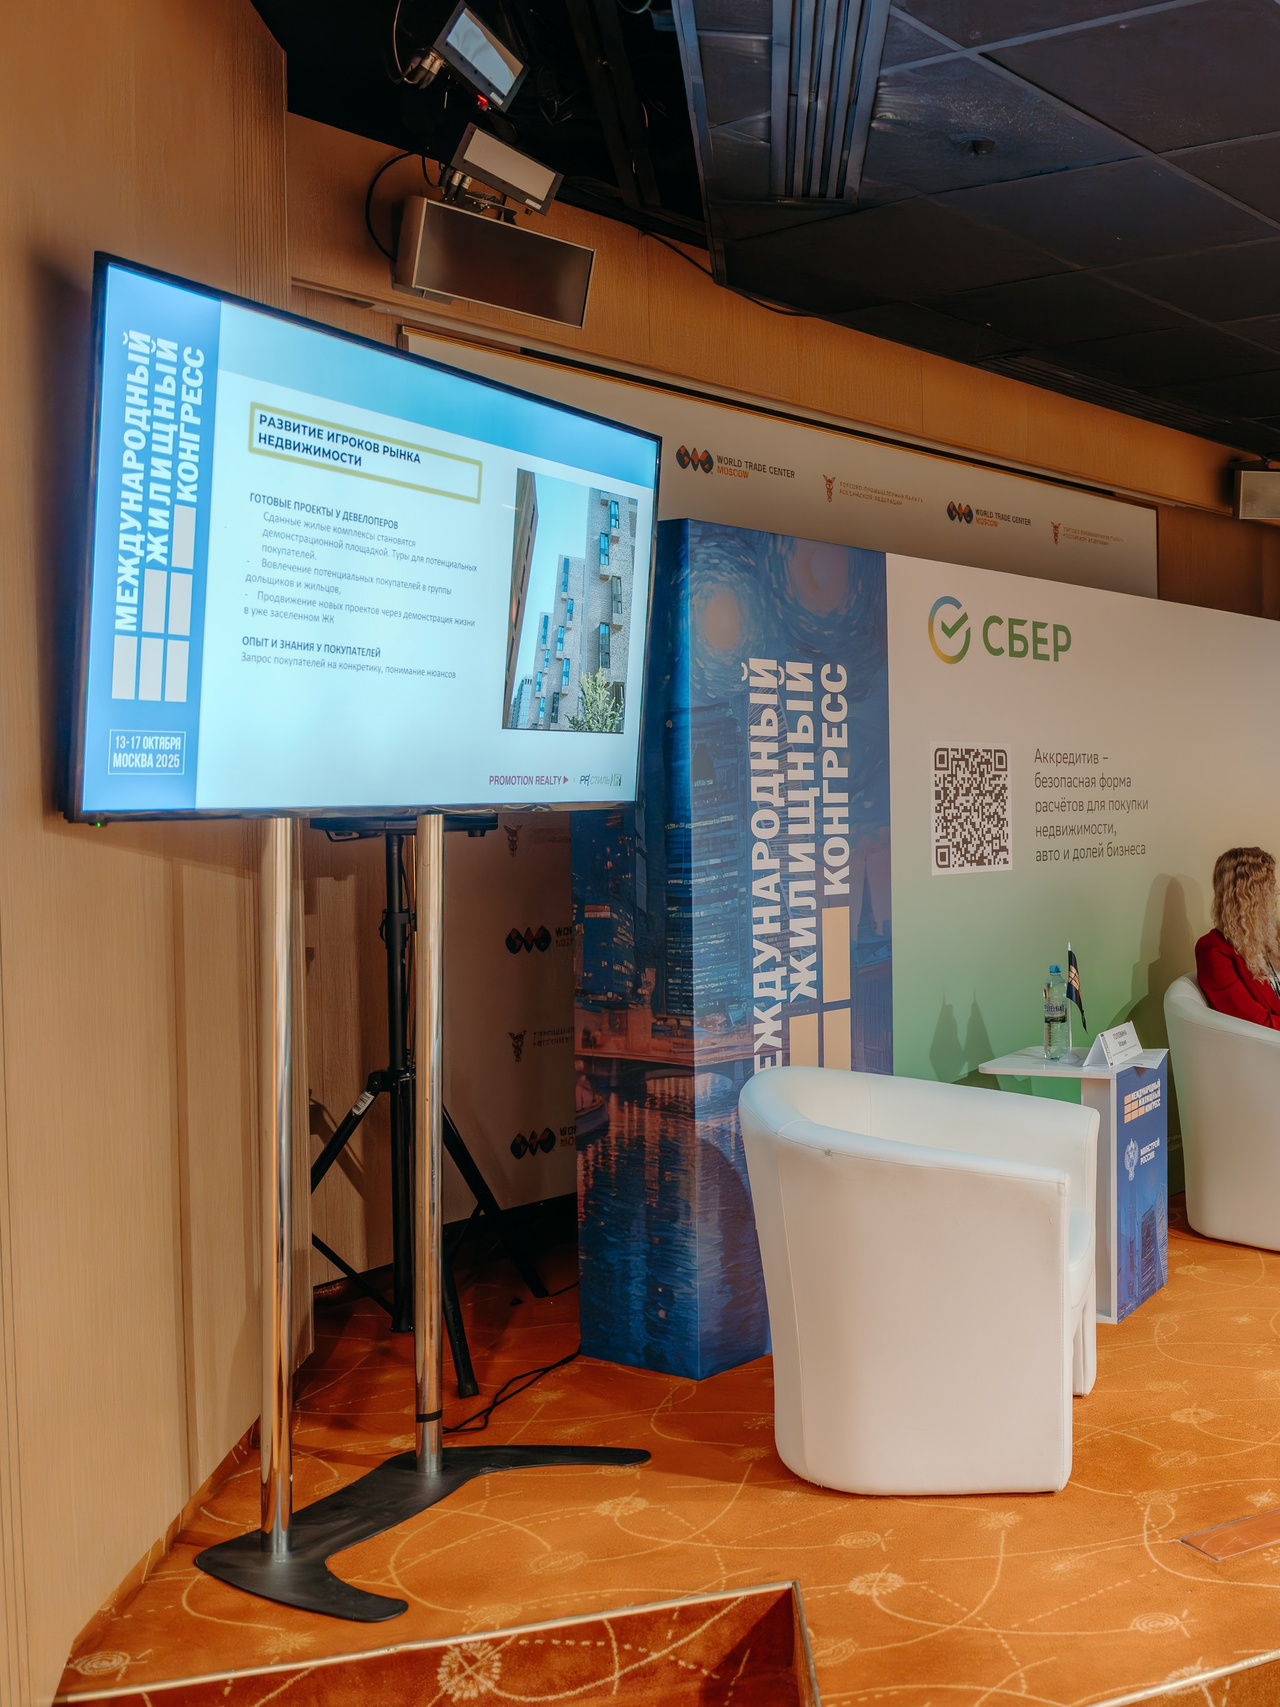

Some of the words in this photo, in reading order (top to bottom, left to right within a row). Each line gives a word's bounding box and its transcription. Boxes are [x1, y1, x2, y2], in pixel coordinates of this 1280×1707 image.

[176, 346, 205, 503] КОНГРЕСС
[146, 337, 179, 566] ЖИЛИЩНЫЙ
[258, 432, 362, 466] НЕДВИЖИМОСТИ
[259, 414, 324, 440] РАЗВИТИЕ
[326, 430, 380, 453] ИГРОКОВ
[382, 444, 421, 464] РЫНКА
[716, 454, 743, 468] WORLD
[745, 460, 767, 473] TRADE
[769, 465, 795, 479] CENTER
[717, 466, 749, 479] MOSCOW
[114, 329, 151, 631] МЕЖДУНАРОДНЫЙ
[249, 492, 292, 509] ГОТОВЫЕ
[294, 501, 333, 518] ПРОЕКТЫ
[335, 509, 341, 518] У
[342, 511, 399, 529] ДЕВЕЛОПЕРОВ
[975, 508, 994, 519] WORLD
[995, 511, 1011, 522] TRADE
[1012, 516, 1031, 526] CENTER
[975, 517, 998, 527] MOSCOW
[263, 511, 301, 527] Сданные
[303, 520, 331, 532] жилые
[332, 525, 375, 540] комплексы
[377, 535, 416, 547] становятся
[262, 528, 343, 549] демонстрационной
[345, 543, 390, 557] площадкой.
[392, 549, 410, 561] Туры
[411, 555, 424, 563] для
[425, 557, 478, 572] потенциальных
[262, 544, 317, 560] покупателей.
[245, 574, 294, 588] дольщиков
[303, 582, 341, 595] жильцов,
[261, 558, 312, 575] Вовлечение
[313, 567, 374, 584] потенциальных
[375, 577, 421, 591] покупателей
[427, 585, 452, 595] группы
[251, 607, 268, 617] уже
[270, 609, 320, 622] заселенном
[321, 614, 335, 624] ЖК
[257, 590, 317, 607] Продвижение
[318, 601, 343, 610] новых
[345, 603, 379, 615] проектов
[381, 608, 402, 619] через
[403, 611, 453, 625] демонстрация
[454, 619, 475, 627] жизни
[242, 636, 269, 647] ОПЫТ
[271, 639, 278, 649] И
[279, 639, 315, 652] ЗНАНИЯ
[316, 643, 322, 653] У
[324, 643, 381, 658] ПОКУПАТЕЛЕЙ
[982, 614, 1072, 663] СБЕР
[241, 652, 272, 665] Запрос
[273, 656, 326, 668] покупателей
[327, 661, 337, 669] на
[338, 662, 383, 674] конкретику,
[385, 665, 425, 676] понимание
[426, 669, 456, 679] нюансов
[115, 735, 141, 749] 13-17
[142, 736, 181, 751] ОКТЯБРЯ
[113, 752, 153, 768] МОСКВА
[156, 753, 180, 768] 2025
[1034, 748, 1099, 767] Аккредитив
[489, 775, 531, 785] PROMOTION
[535, 775, 562, 785] REALTY
[821, 663, 850, 896] КОНГРЕСС
[1034, 771, 1096, 788] безопасная
[1099, 772, 1132, 791] форма
[1035, 797, 1084, 814] расчётов
[1087, 800, 1106, 813] для
[1108, 799, 1149, 813] покупки
[778, 661, 820, 1003] ЖИЛИЩНЫЙ
[1035, 823, 1117, 839] недвижимости,
[1036, 849, 1060, 862] авто
[1063, 849, 1069, 860] и
[1072, 843, 1104, 862] долей
[1107, 842, 1146, 857] бизнеса
[741, 657, 787, 1075] ЕЖДУНАРОДНЫЙ
